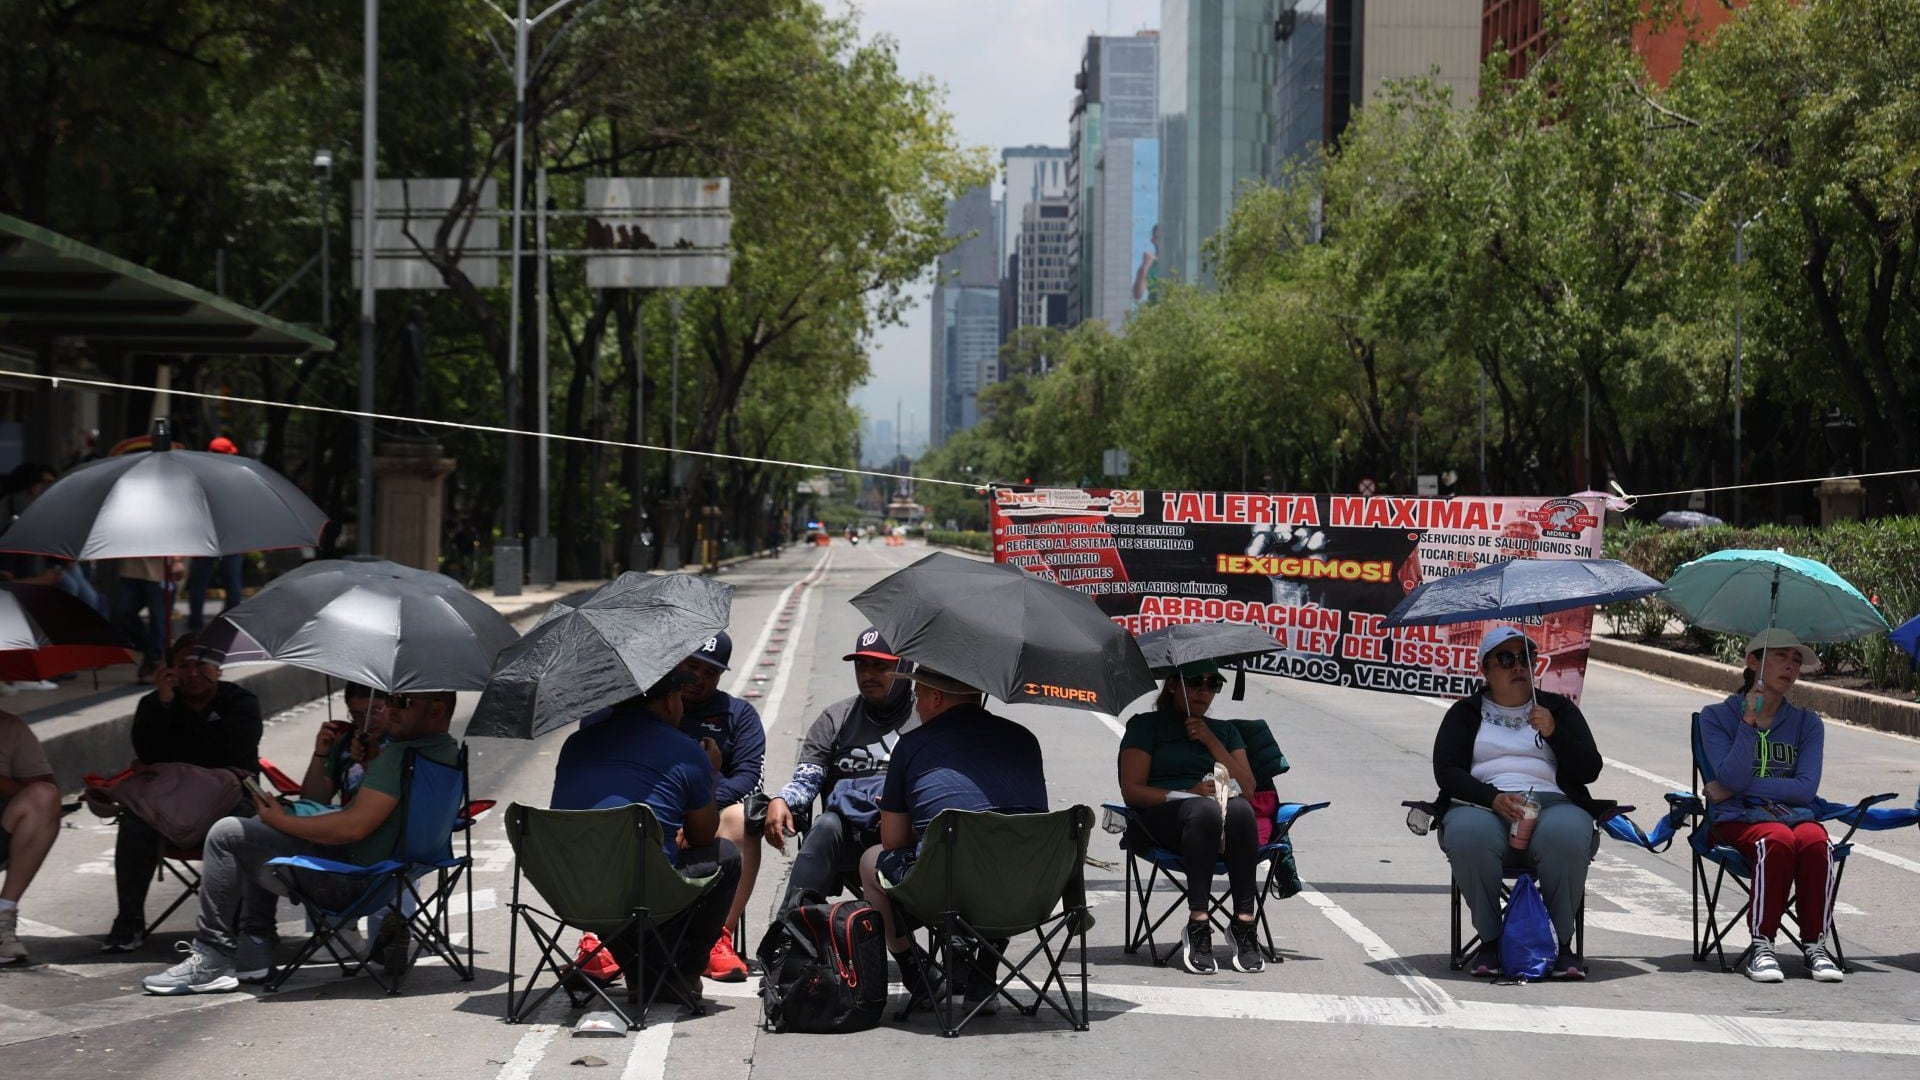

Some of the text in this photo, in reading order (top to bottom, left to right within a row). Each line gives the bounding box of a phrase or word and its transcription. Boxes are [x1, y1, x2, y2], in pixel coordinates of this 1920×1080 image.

[1113, 491, 1140, 506] 34
[1162, 492, 1320, 526] ¡ALERTA
[1006, 521, 1185, 536] JUBILACIÓN POR AÑOS DE SERVICIO
[1006, 538, 1194, 552] REGRESO AL SISTEMA DE SEGURIDAD
[1420, 533, 1592, 558] SERVICIOS DE SALUD DIGNOS SIN
[1006, 553, 1099, 566] SOCIAL SOLIDARIO
[1420, 548, 1456, 561] TOCAR
[1458, 551, 1470, 562] EL
[1060, 569, 1071, 581] NI
[1073, 568, 1114, 580] AFORES
[1218, 555, 1393, 581] ¡EXIGIMOS!
[1112, 582, 1126, 593] EN
[1128, 582, 1179, 594] SALARIOS
[1181, 581, 1228, 595] MÍNIMOS
[1140, 596, 1341, 632] ABROGACIÓN
[1296, 628, 1340, 656] LEY
[1342, 633, 1387, 662] DEL
[1392, 640, 1479, 672] ISSSTE
[1355, 663, 1485, 696] VENCEREM
[1041, 684, 1098, 703] TRUPER
